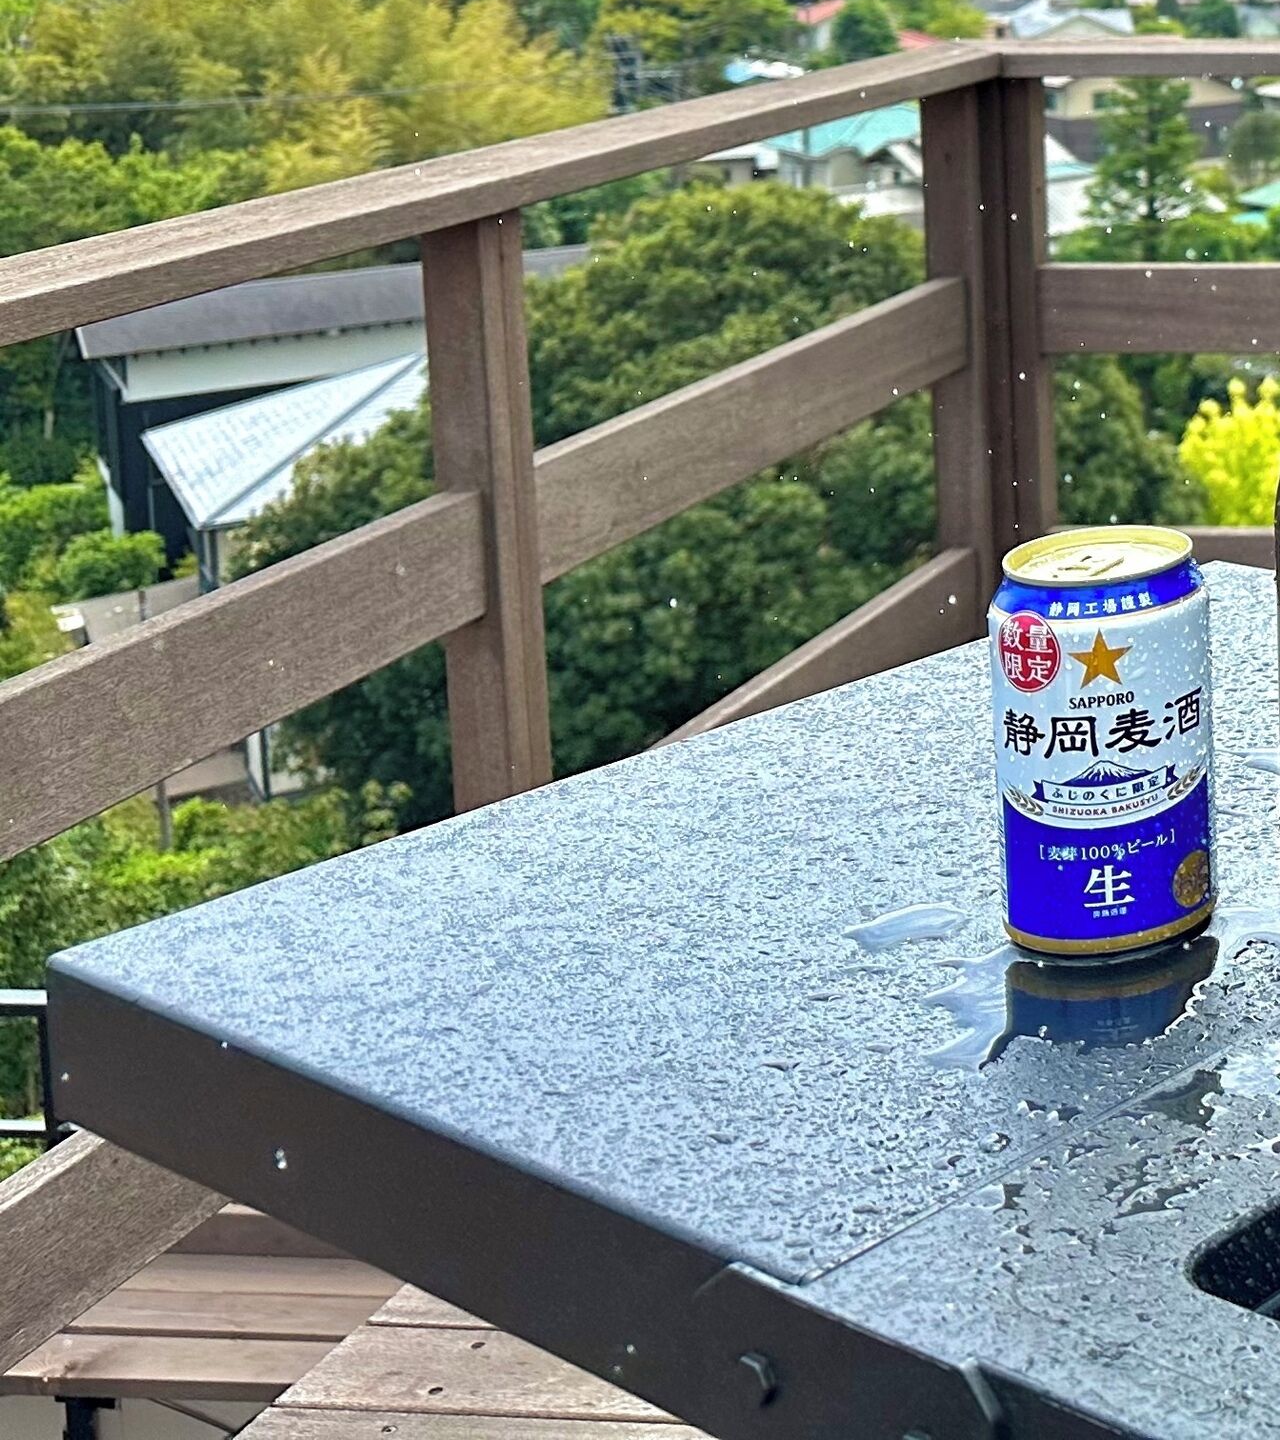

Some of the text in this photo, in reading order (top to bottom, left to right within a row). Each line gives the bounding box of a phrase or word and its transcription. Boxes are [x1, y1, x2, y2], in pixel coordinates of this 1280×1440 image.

[1049, 591, 1153, 617] 静岡工場謹製
[1002, 620, 1053, 653] 数量
[1003, 652, 1052, 682] 限定
[1068, 691, 1134, 709] SAPPORO
[1003, 686, 1202, 759] 静岡麦酒
[1052, 774, 1161, 801] ふじのくに限定
[1052, 793, 1158, 817] SHIZUOKA BAKUSYU
[1083, 865, 1136, 908] 生
